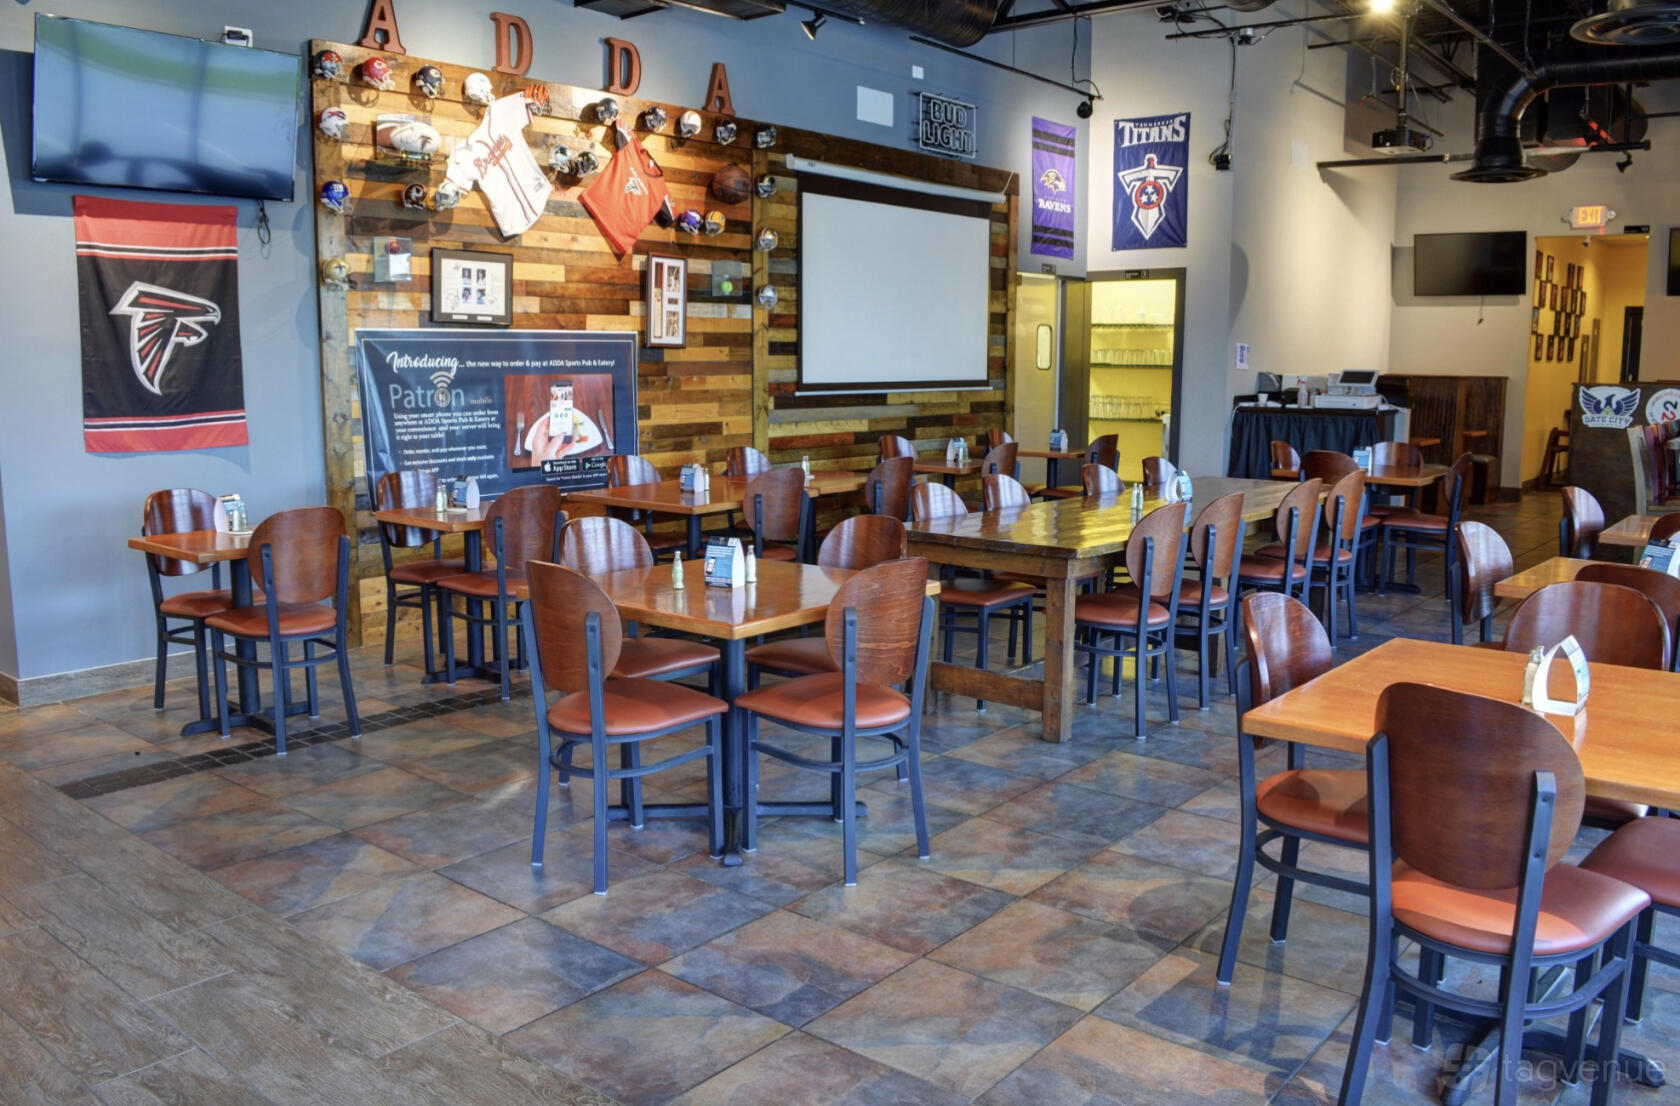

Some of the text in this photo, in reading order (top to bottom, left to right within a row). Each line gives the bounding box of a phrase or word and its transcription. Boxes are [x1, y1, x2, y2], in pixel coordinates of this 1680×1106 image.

[930, 99, 967, 128] BUD
[923, 120, 975, 153] LIGHT
[1119, 115, 1187, 148] TITANS
[1038, 198, 1072, 214] RAVENS
[1578, 206, 1603, 225] EXIT
[466, 360, 476, 368] the
[490, 361, 502, 369] way
[503, 360, 509, 368] to
[510, 359, 525, 368] order
[531, 360, 542, 369] pay
[565, 359, 581, 369] Sports
[582, 359, 592, 367] Pub
[563, 463, 577, 471] Store
